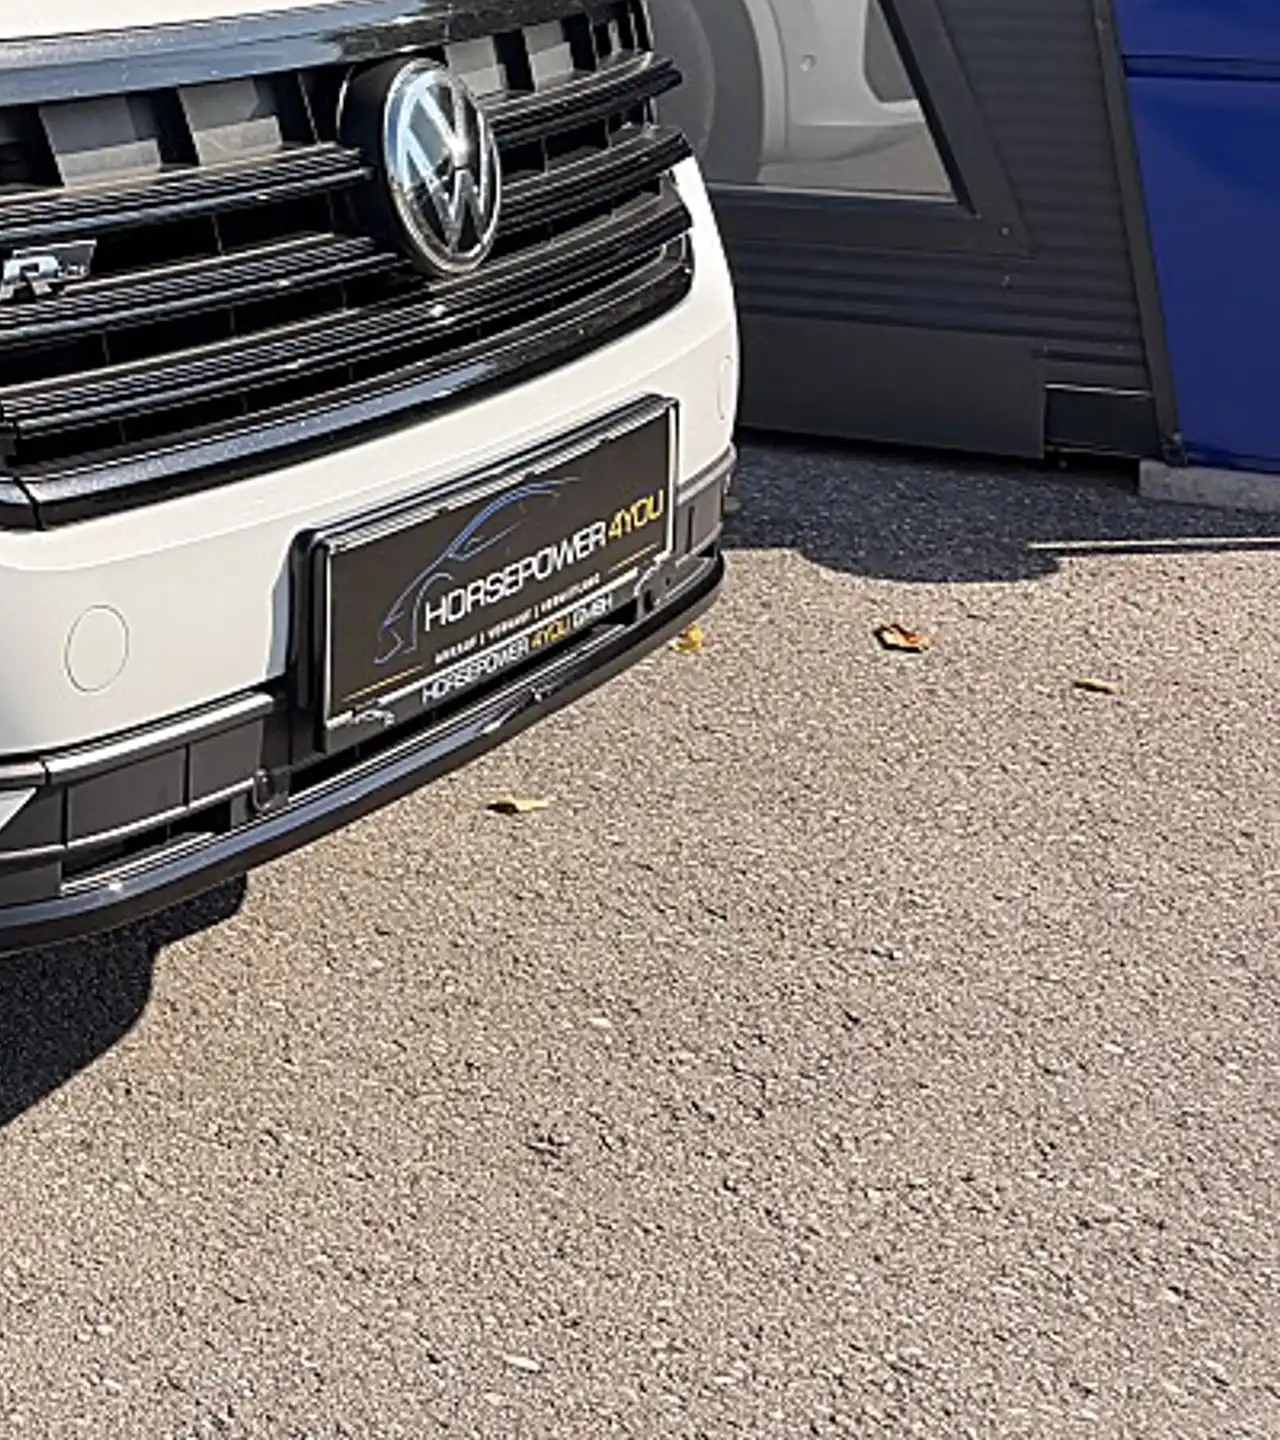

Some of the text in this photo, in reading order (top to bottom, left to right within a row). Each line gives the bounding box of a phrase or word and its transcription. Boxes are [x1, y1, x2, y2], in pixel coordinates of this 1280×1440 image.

[424, 520, 607, 632] HORSEPOWER
[608, 489, 664, 539] 4YOU
[421, 634, 530, 704] HORSEPOWER
